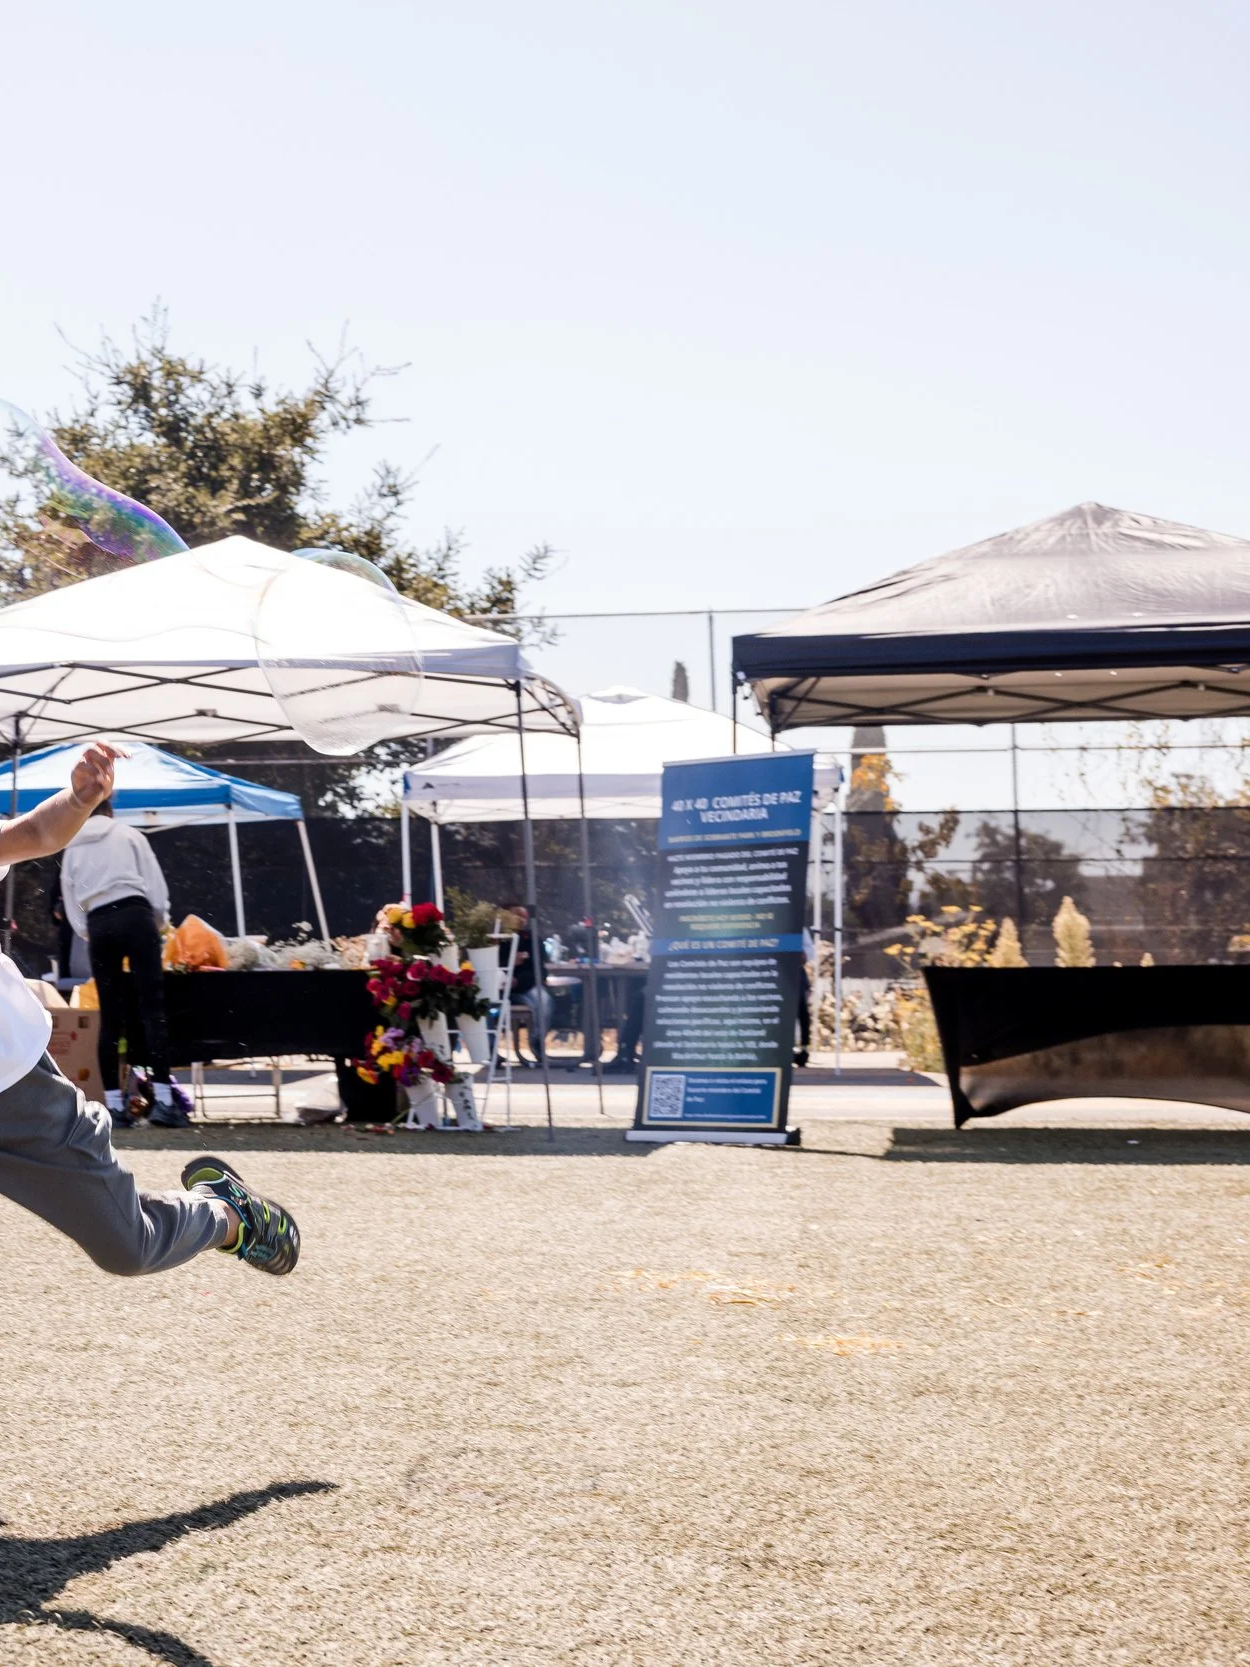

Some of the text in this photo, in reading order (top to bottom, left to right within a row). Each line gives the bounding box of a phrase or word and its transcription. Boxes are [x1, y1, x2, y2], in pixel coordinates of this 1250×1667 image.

[671, 800, 685, 812] 40
[694, 798, 709, 810] 40
[762, 792, 778, 805] DE
[779, 790, 802, 803] PAZ
[700, 807, 769, 823] VECINDARIA
